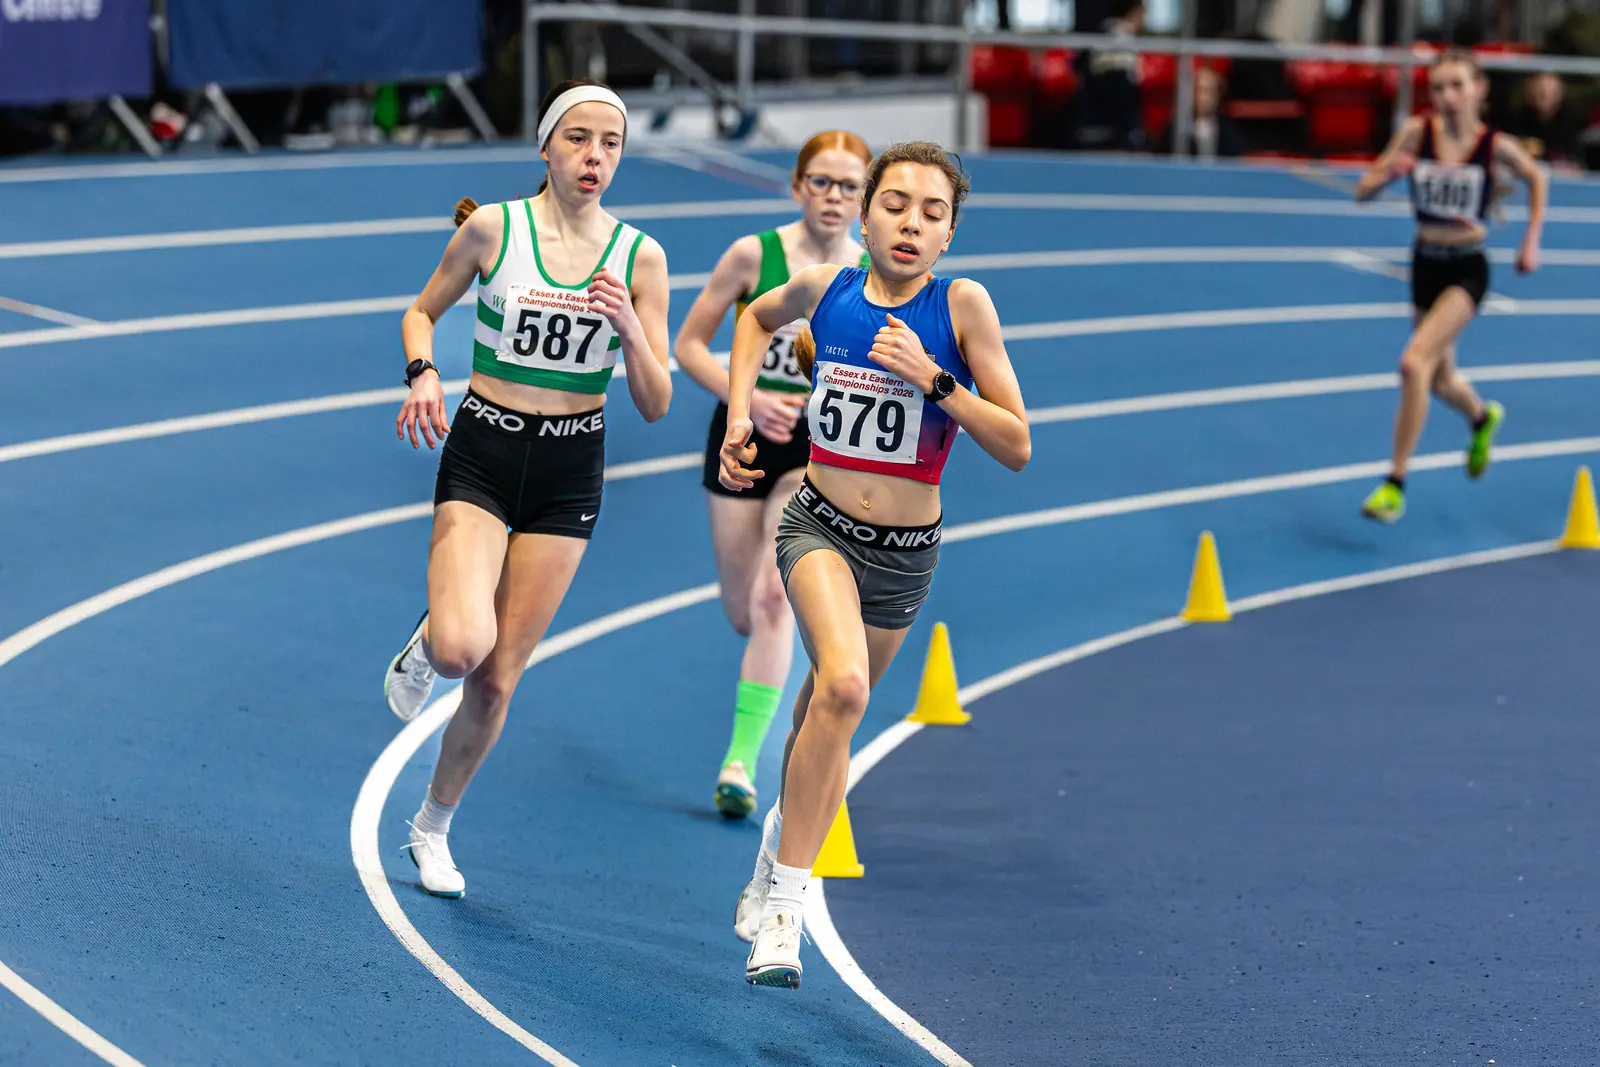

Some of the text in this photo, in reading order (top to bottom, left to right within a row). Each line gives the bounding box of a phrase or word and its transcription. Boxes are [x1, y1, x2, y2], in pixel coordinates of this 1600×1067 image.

[517, 296, 585, 312] Championships
[529, 288, 590, 304] Essex & Easte
[513, 309, 602, 364] 587
[824, 345, 849, 357] TACTIC
[823, 375, 915, 398] Championships 2026
[833, 367, 904, 387] Essex & Eastern
[462, 395, 604, 437] PRO NIKE
[819, 388, 906, 453] 579
[813, 501, 877, 542] PRO
